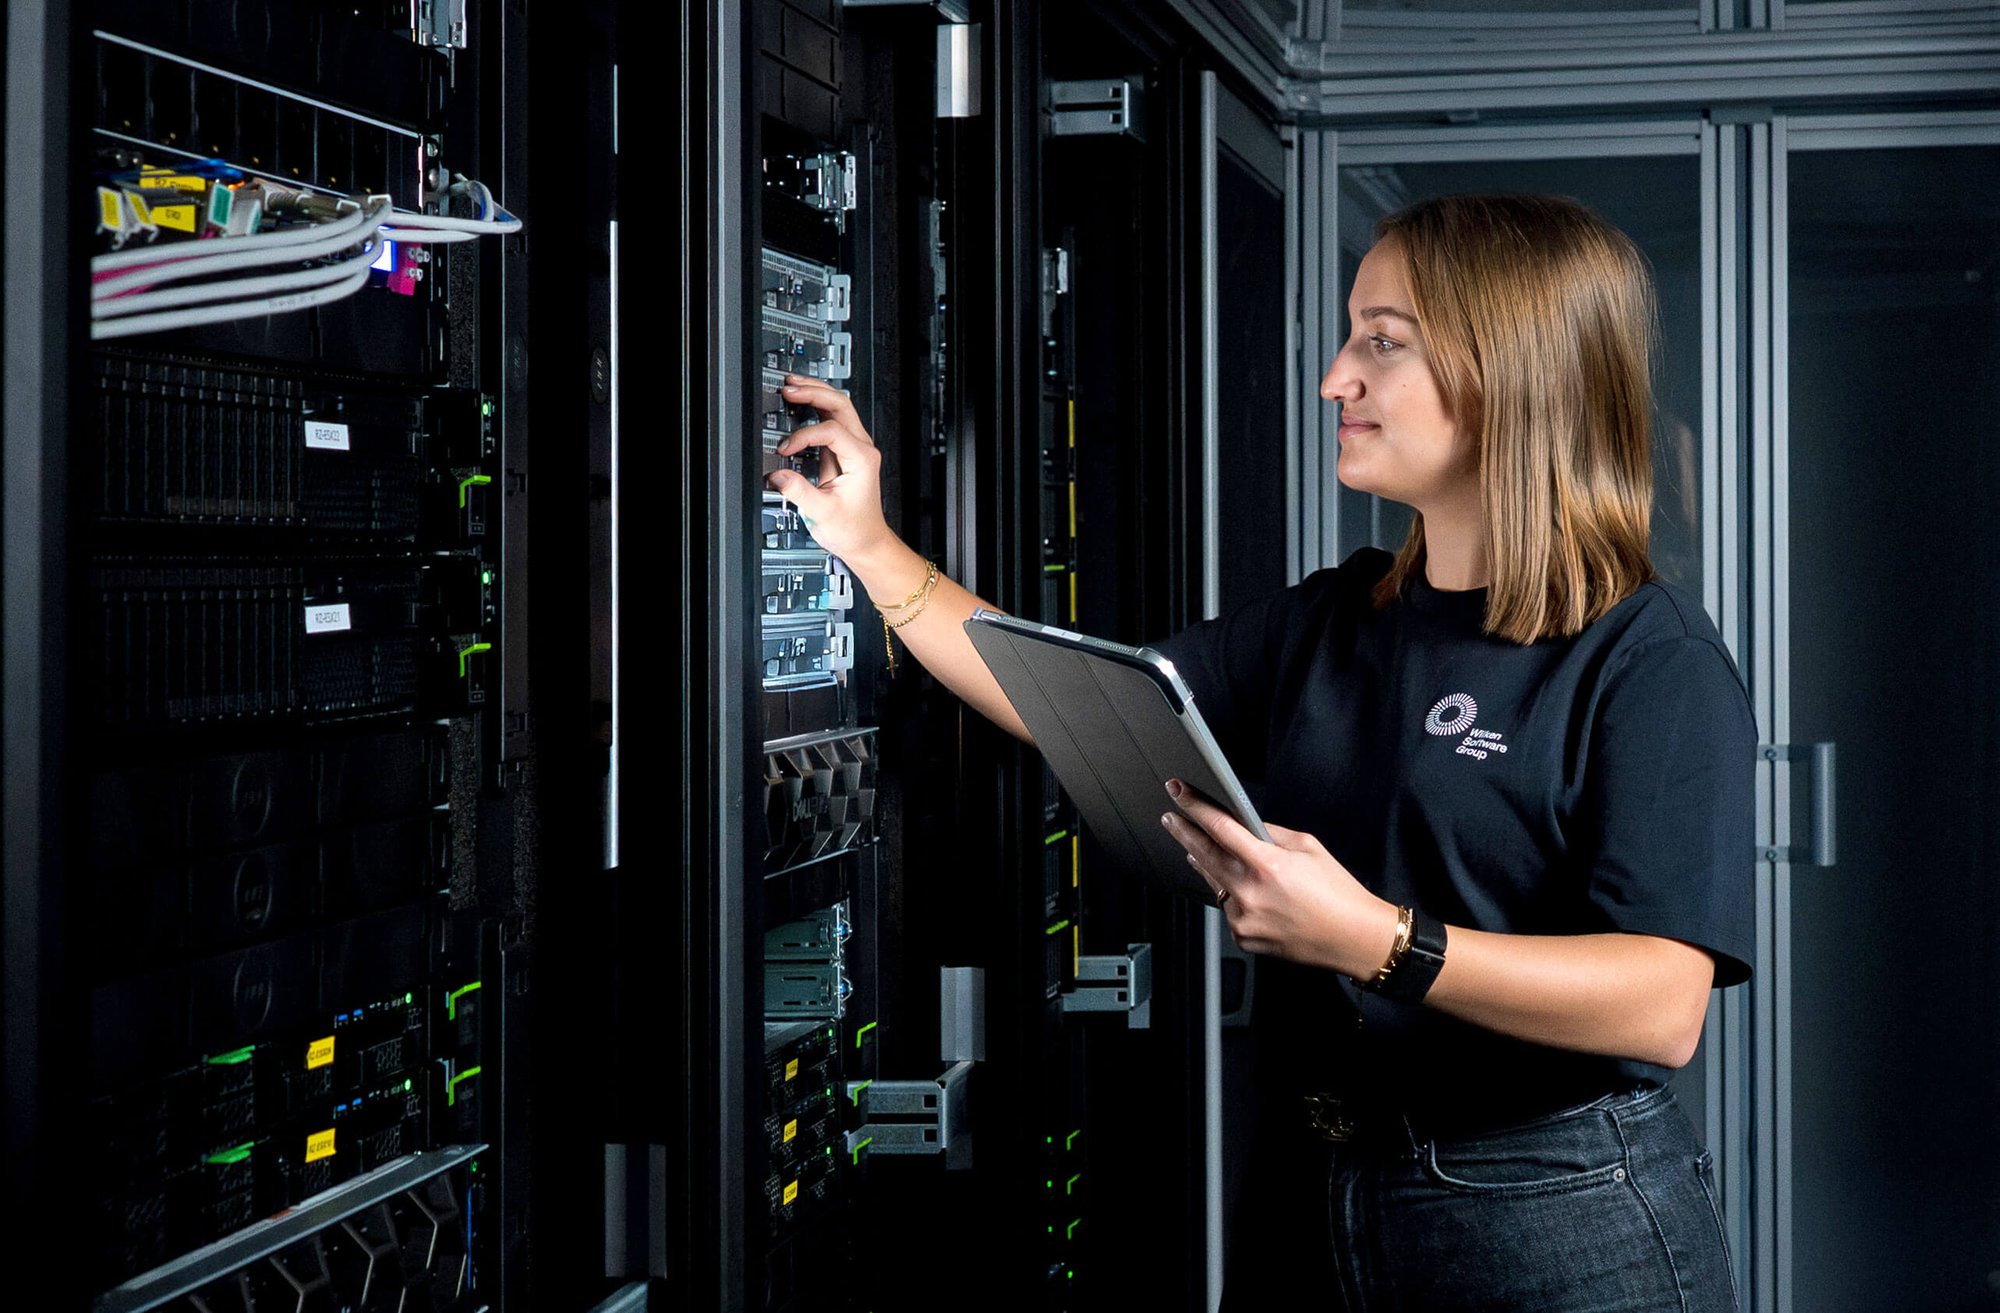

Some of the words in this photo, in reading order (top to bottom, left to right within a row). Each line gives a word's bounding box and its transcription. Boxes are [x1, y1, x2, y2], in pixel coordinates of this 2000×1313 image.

[1469, 728, 1502, 740] Wilken
[1456, 745, 1488, 760] Group
[1462, 737, 1508, 753] Software
